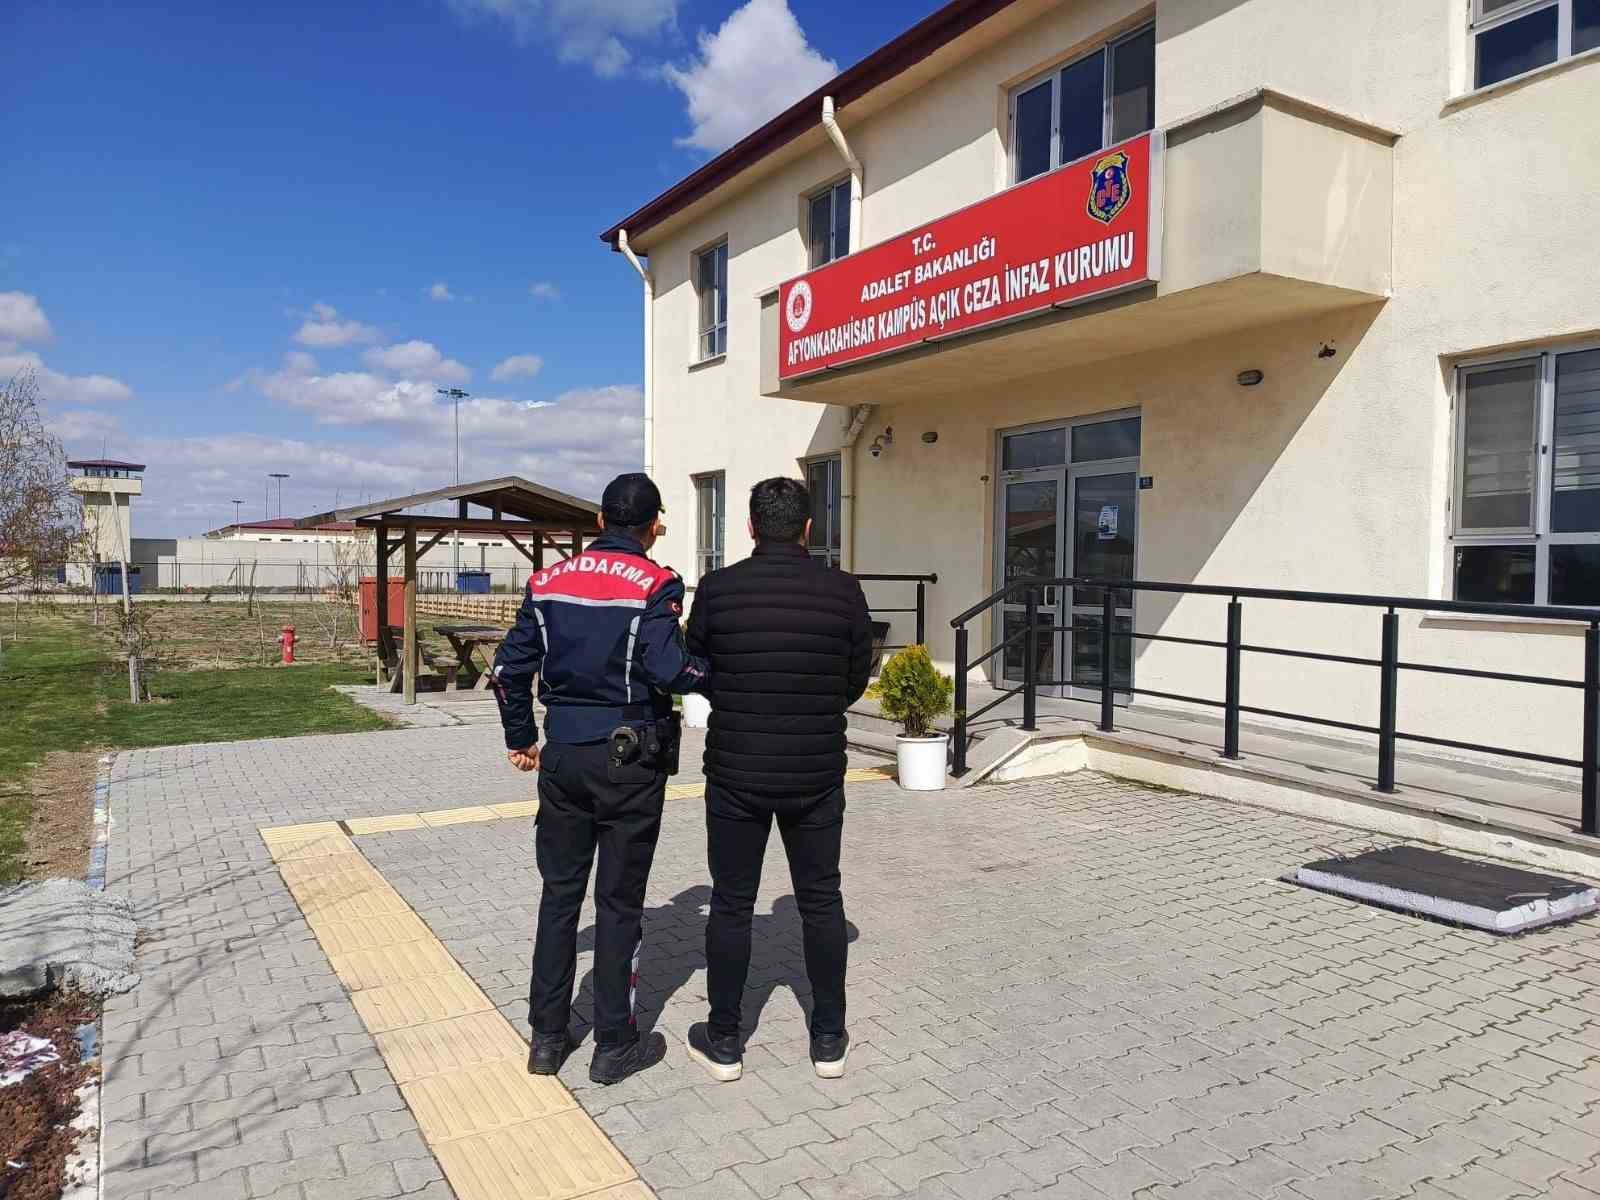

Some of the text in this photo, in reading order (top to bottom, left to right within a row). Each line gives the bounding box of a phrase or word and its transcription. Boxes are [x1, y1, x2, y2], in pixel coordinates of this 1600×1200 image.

[912, 233, 936, 255] T.C.
[861, 237, 995, 303] ADALET BAKANLIĞI
[788, 232, 1133, 366] AFYONKARAHİSAR KAMPÜS AÇIK CEZA İNFAZ KURUMU
[535, 557, 655, 591] JANDARMA
